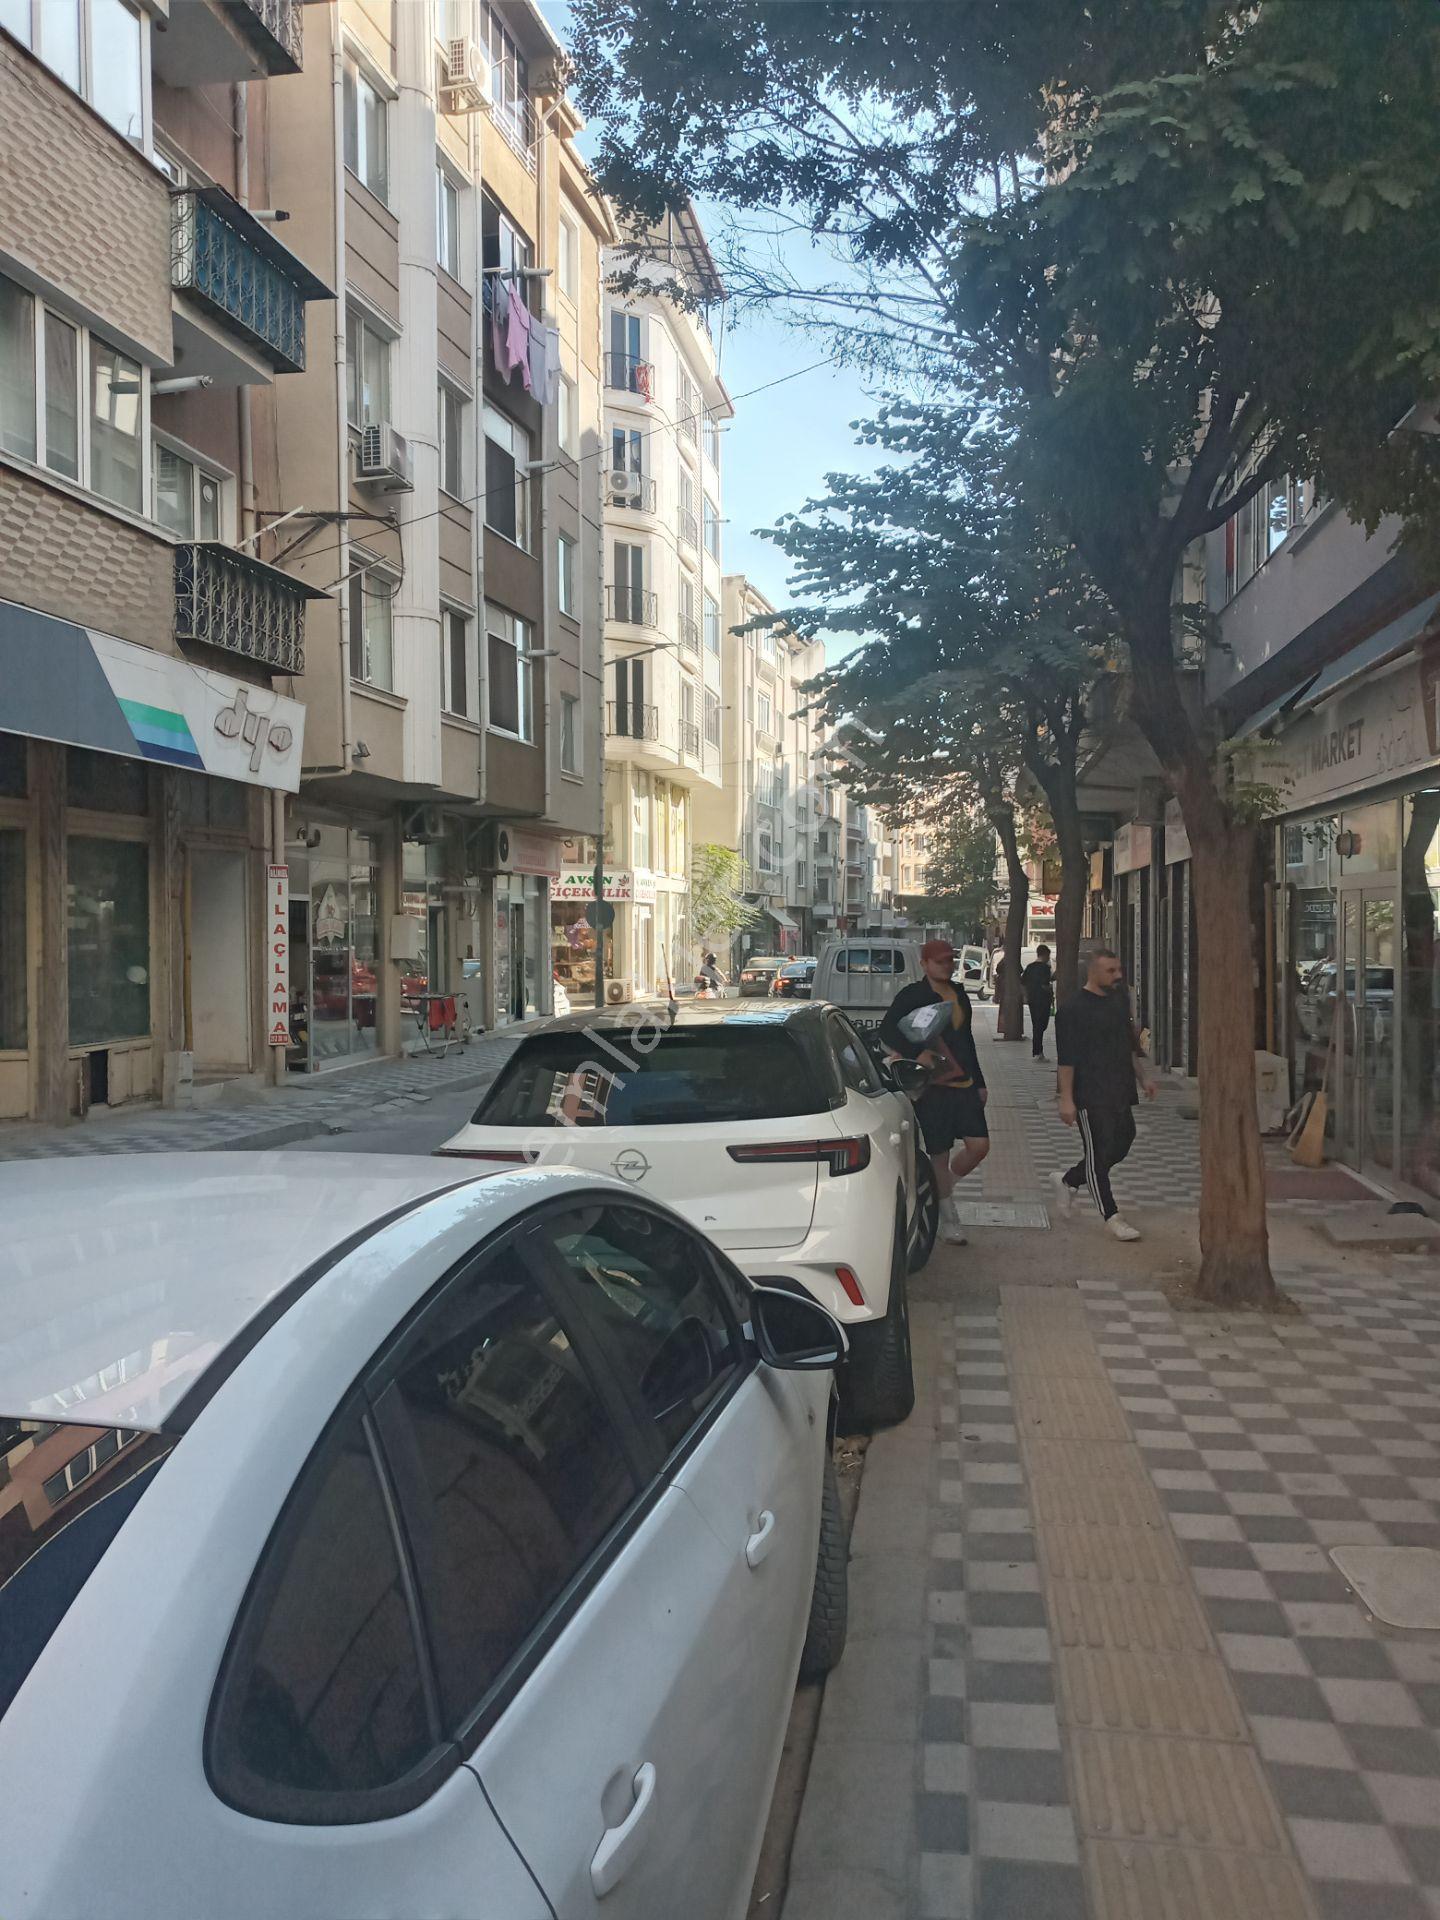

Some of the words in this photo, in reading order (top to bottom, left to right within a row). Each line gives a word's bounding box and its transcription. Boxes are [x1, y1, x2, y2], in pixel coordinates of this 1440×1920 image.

[1311, 719, 1364, 773] MARKET
[565, 875, 614, 885] AVŞN
[272, 882, 288, 1033] İLAÇLAMA
